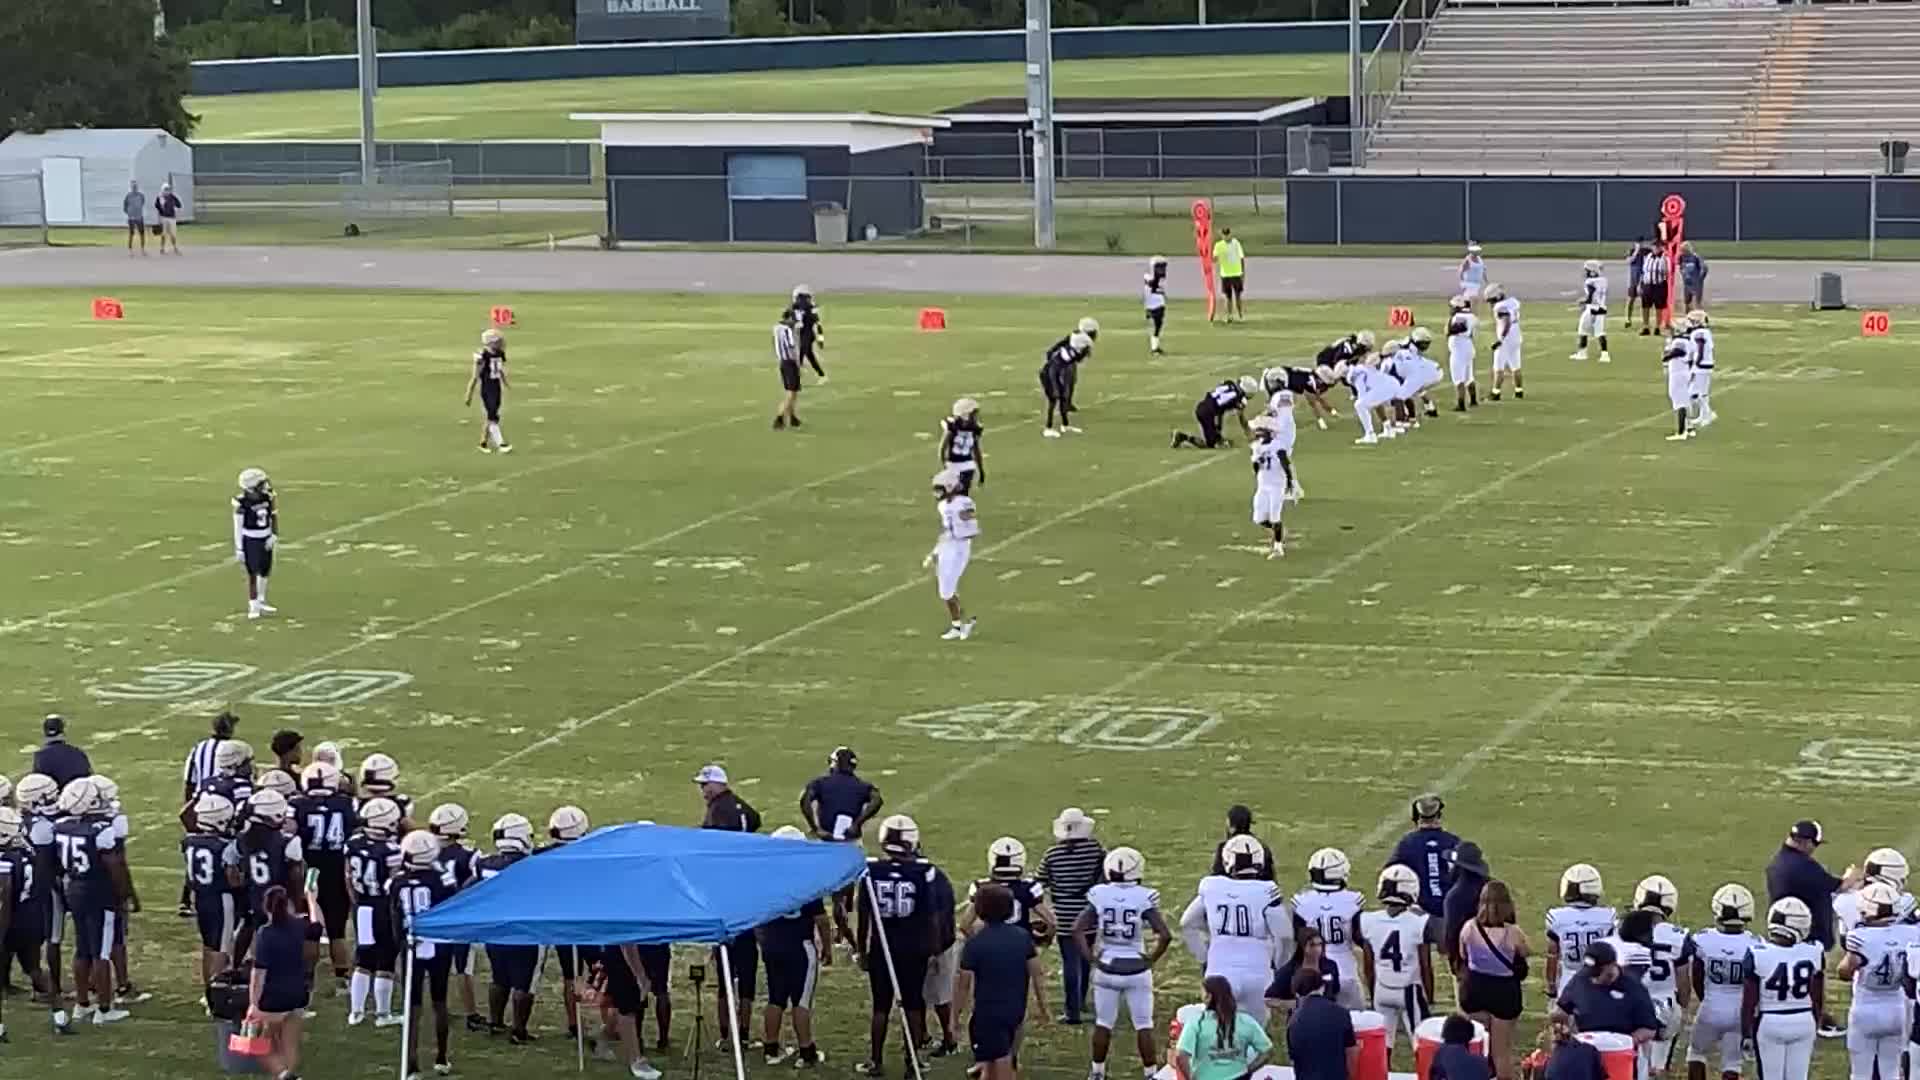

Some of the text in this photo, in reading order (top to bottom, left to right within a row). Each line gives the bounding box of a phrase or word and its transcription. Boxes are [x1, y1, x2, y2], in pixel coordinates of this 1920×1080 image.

[1391, 309, 1409, 326] 30
[1865, 316, 1888, 333] 40
[307, 812, 345, 850] 74
[56, 834, 91, 873] 75
[186, 846, 214, 884] 13
[250, 852, 270, 884] 6
[875, 880, 917, 918] 56
[1103, 907, 1137, 939] 25
[1317, 916, 1345, 944] 16
[1379, 929, 1403, 973] 4
[1709, 959, 1743, 985] 50
[1765, 959, 1815, 1001] 48
